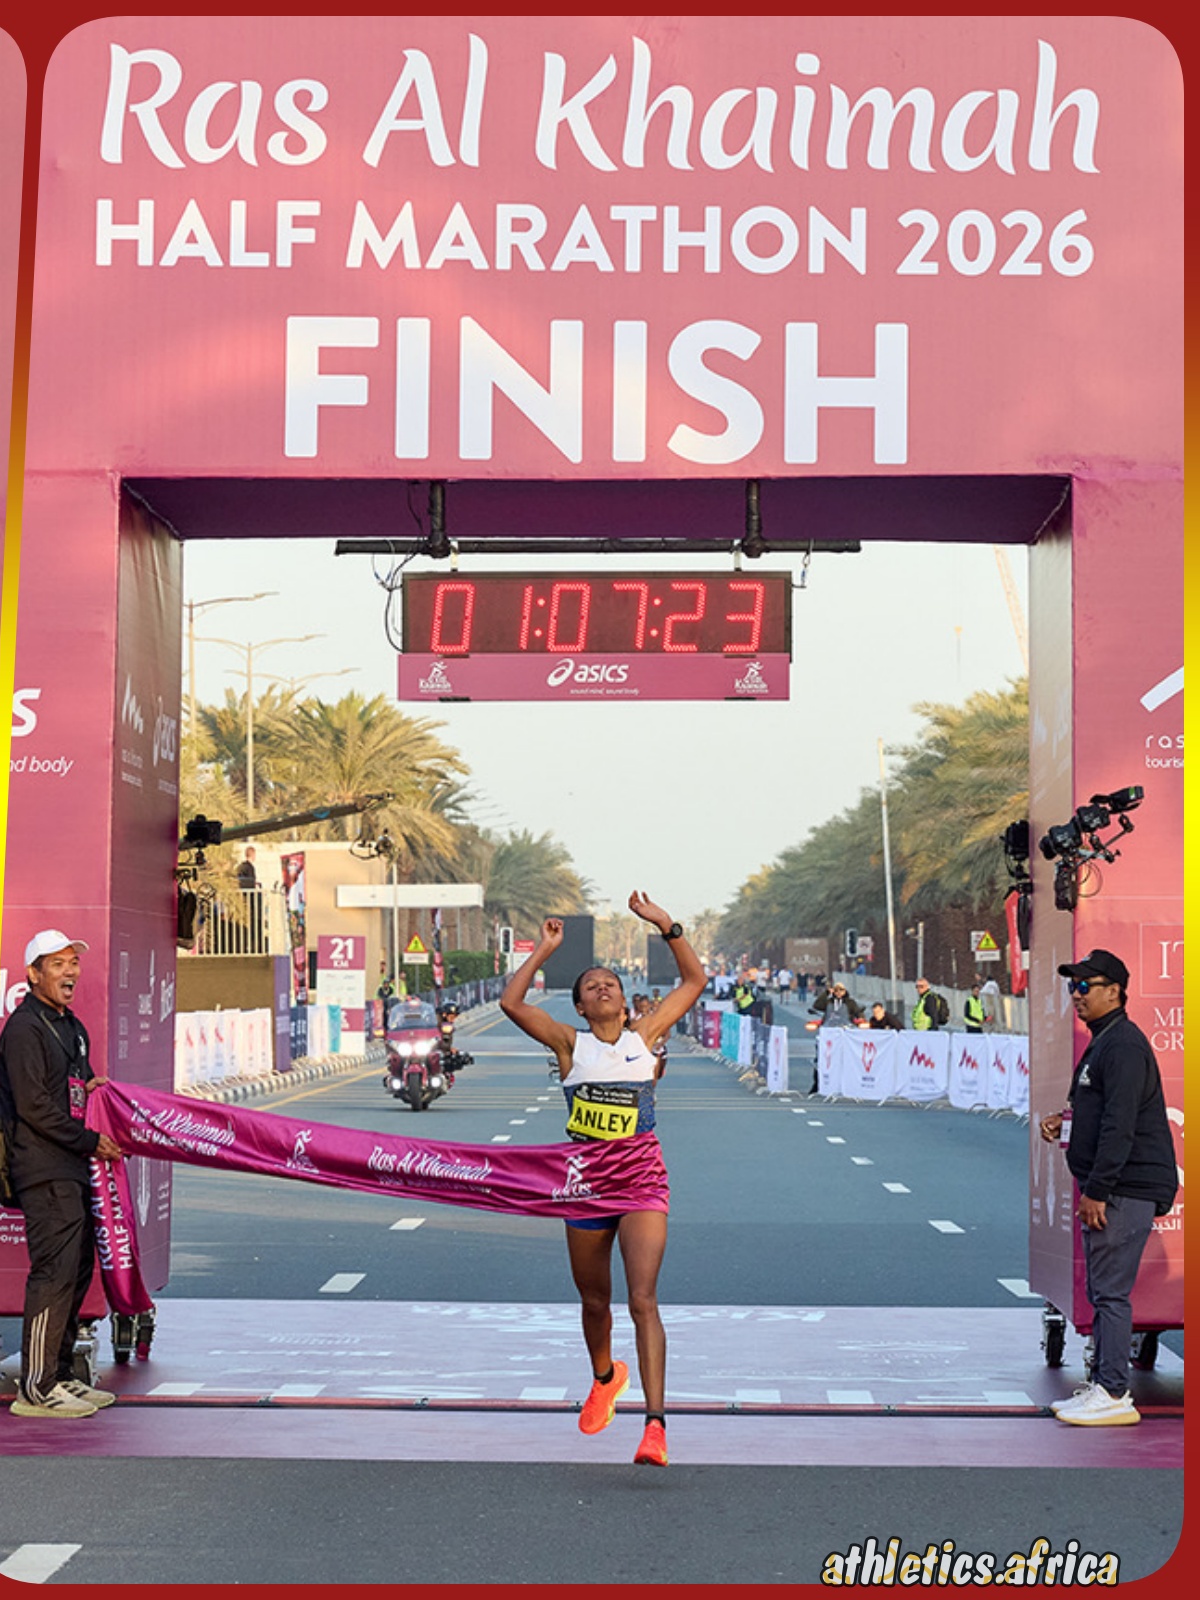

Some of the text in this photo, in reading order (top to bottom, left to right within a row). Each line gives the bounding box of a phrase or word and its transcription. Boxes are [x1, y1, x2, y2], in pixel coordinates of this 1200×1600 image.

[101, 34, 1099, 174] Ras Al Khaimah
[96, 199, 1094, 276] HALF MARATHON 2026
[285, 316, 908, 464] FINISH
[29, 756, 74, 777] body
[1145, 755, 1184, 768] touris
[329, 937, 354, 960] 21
[333, 960, 349, 968] KM
[573, 1106, 632, 1134] ANLEY
[396, 1150, 420, 1175] Al
[415, 1153, 493, 1181] Khaimah
[114, 1225, 134, 1269] HALF
